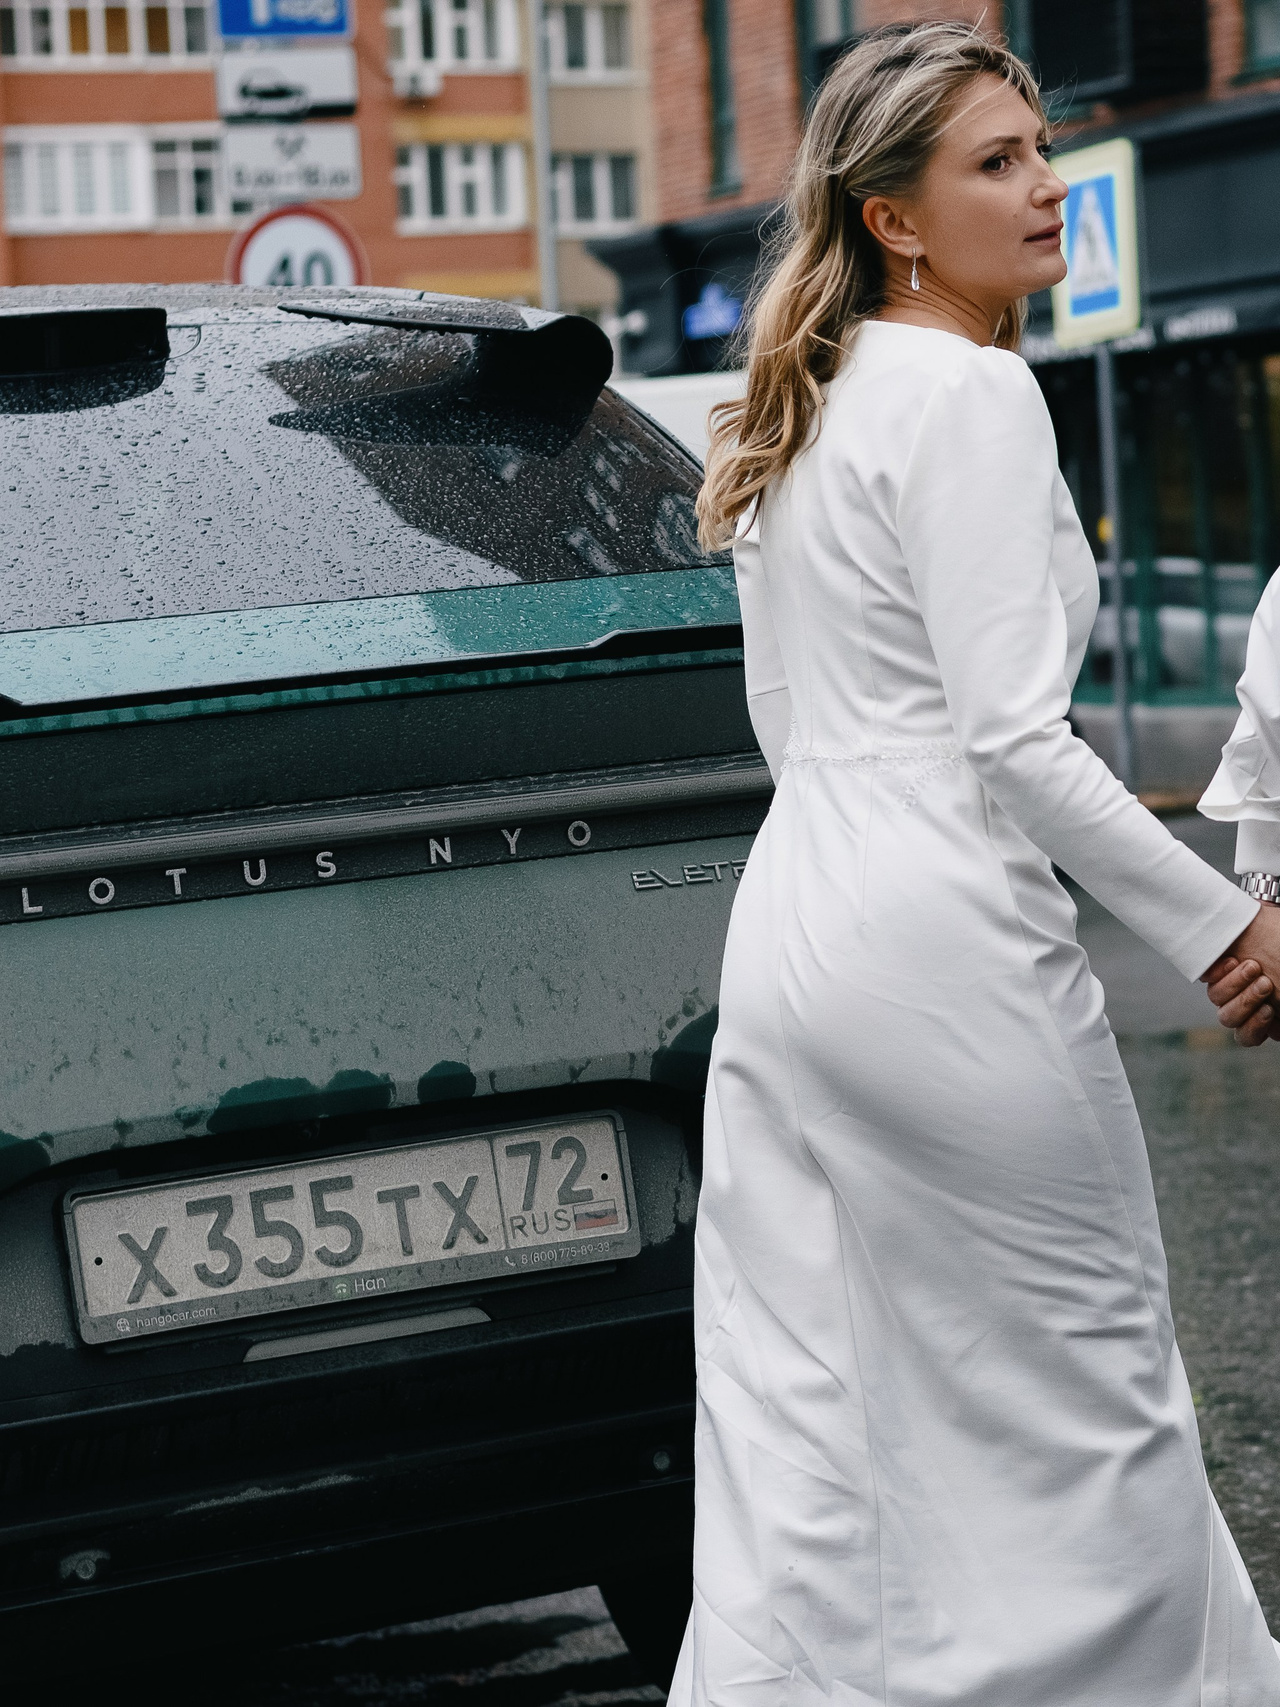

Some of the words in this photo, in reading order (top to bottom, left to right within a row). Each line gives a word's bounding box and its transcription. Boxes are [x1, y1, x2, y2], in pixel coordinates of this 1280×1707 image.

[266, 252, 333, 286] 40
[21, 851, 337, 915] LOTUS
[429, 820, 592, 865] NYO
[505, 1136, 594, 1212] 72
[510, 1209, 571, 1239] RUS
[521, 1253, 529, 1265] 8
[530, 1249, 558, 1265] (800)
[136, 1307, 216, 1328] hangocar.com
